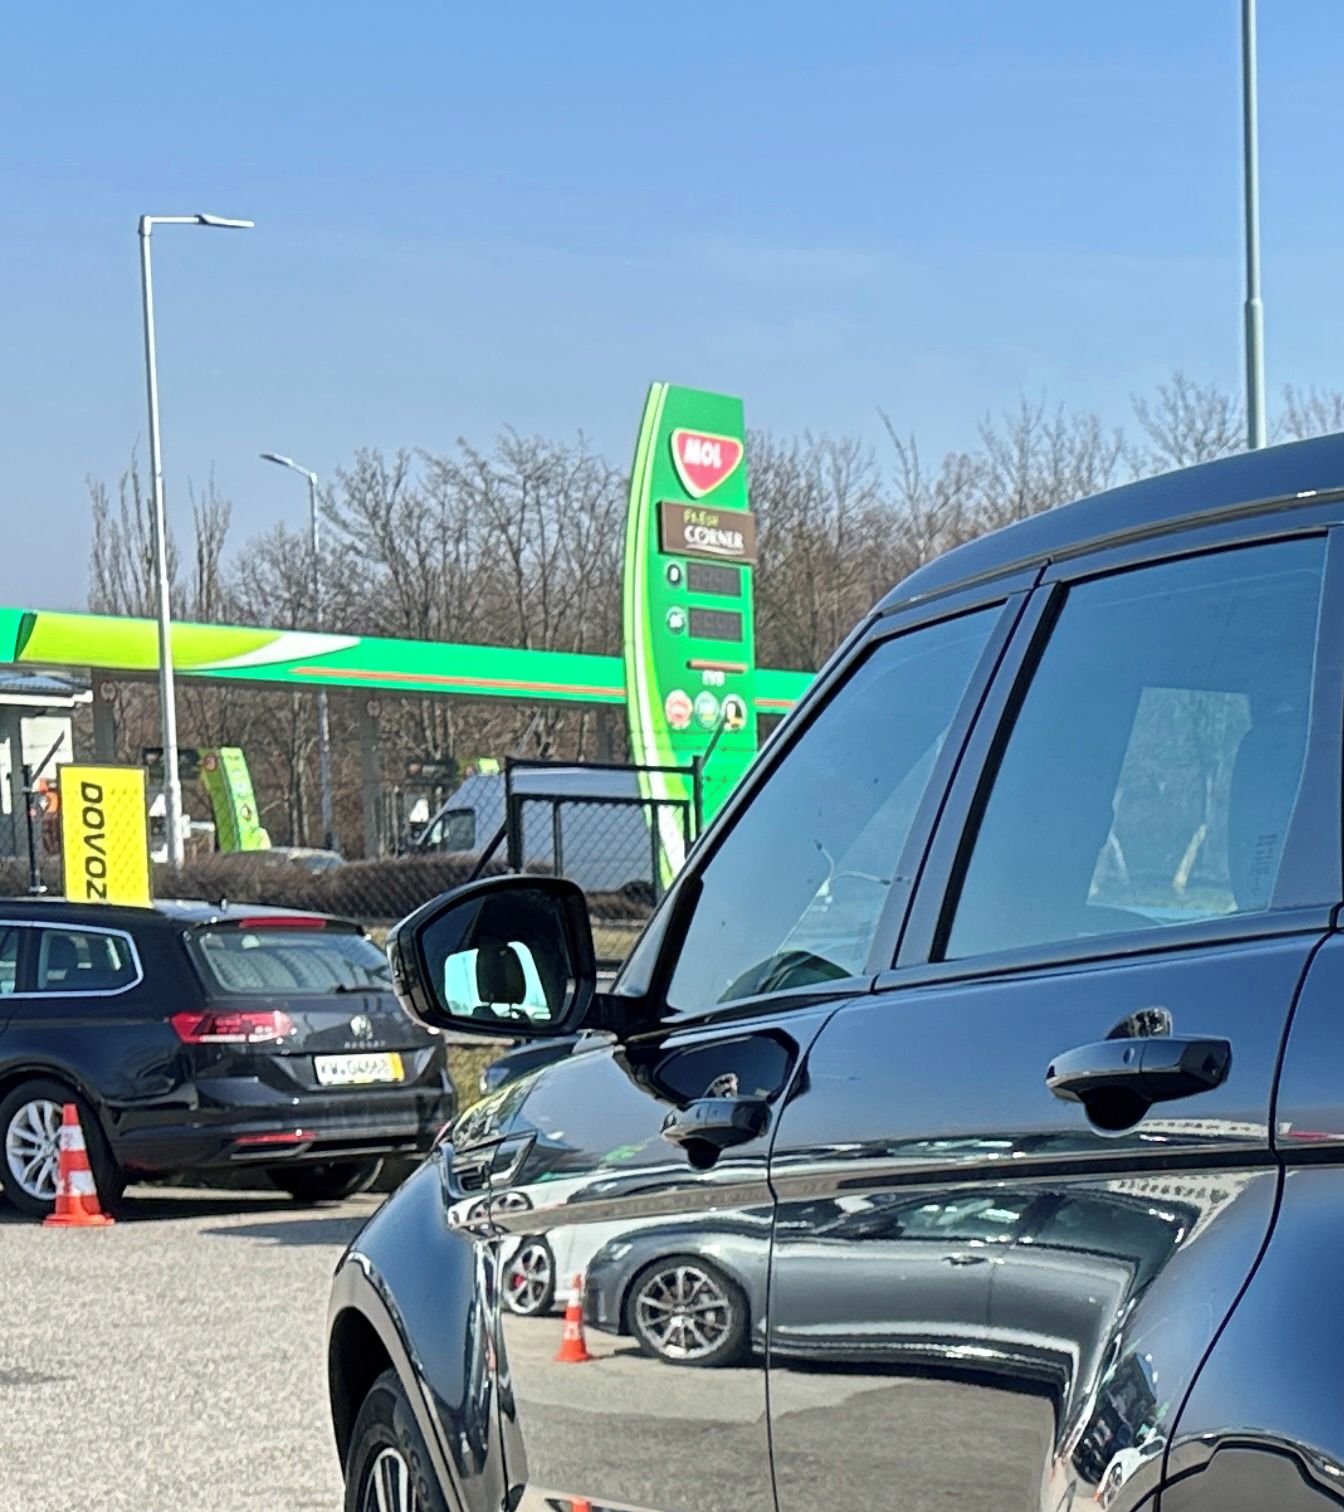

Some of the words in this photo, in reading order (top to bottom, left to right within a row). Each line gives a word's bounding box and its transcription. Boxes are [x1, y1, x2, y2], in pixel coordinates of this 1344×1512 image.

[684, 437, 722, 469] MOL
[684, 525, 744, 550] CORNER
[80, 781, 108, 899] DOVOZ
